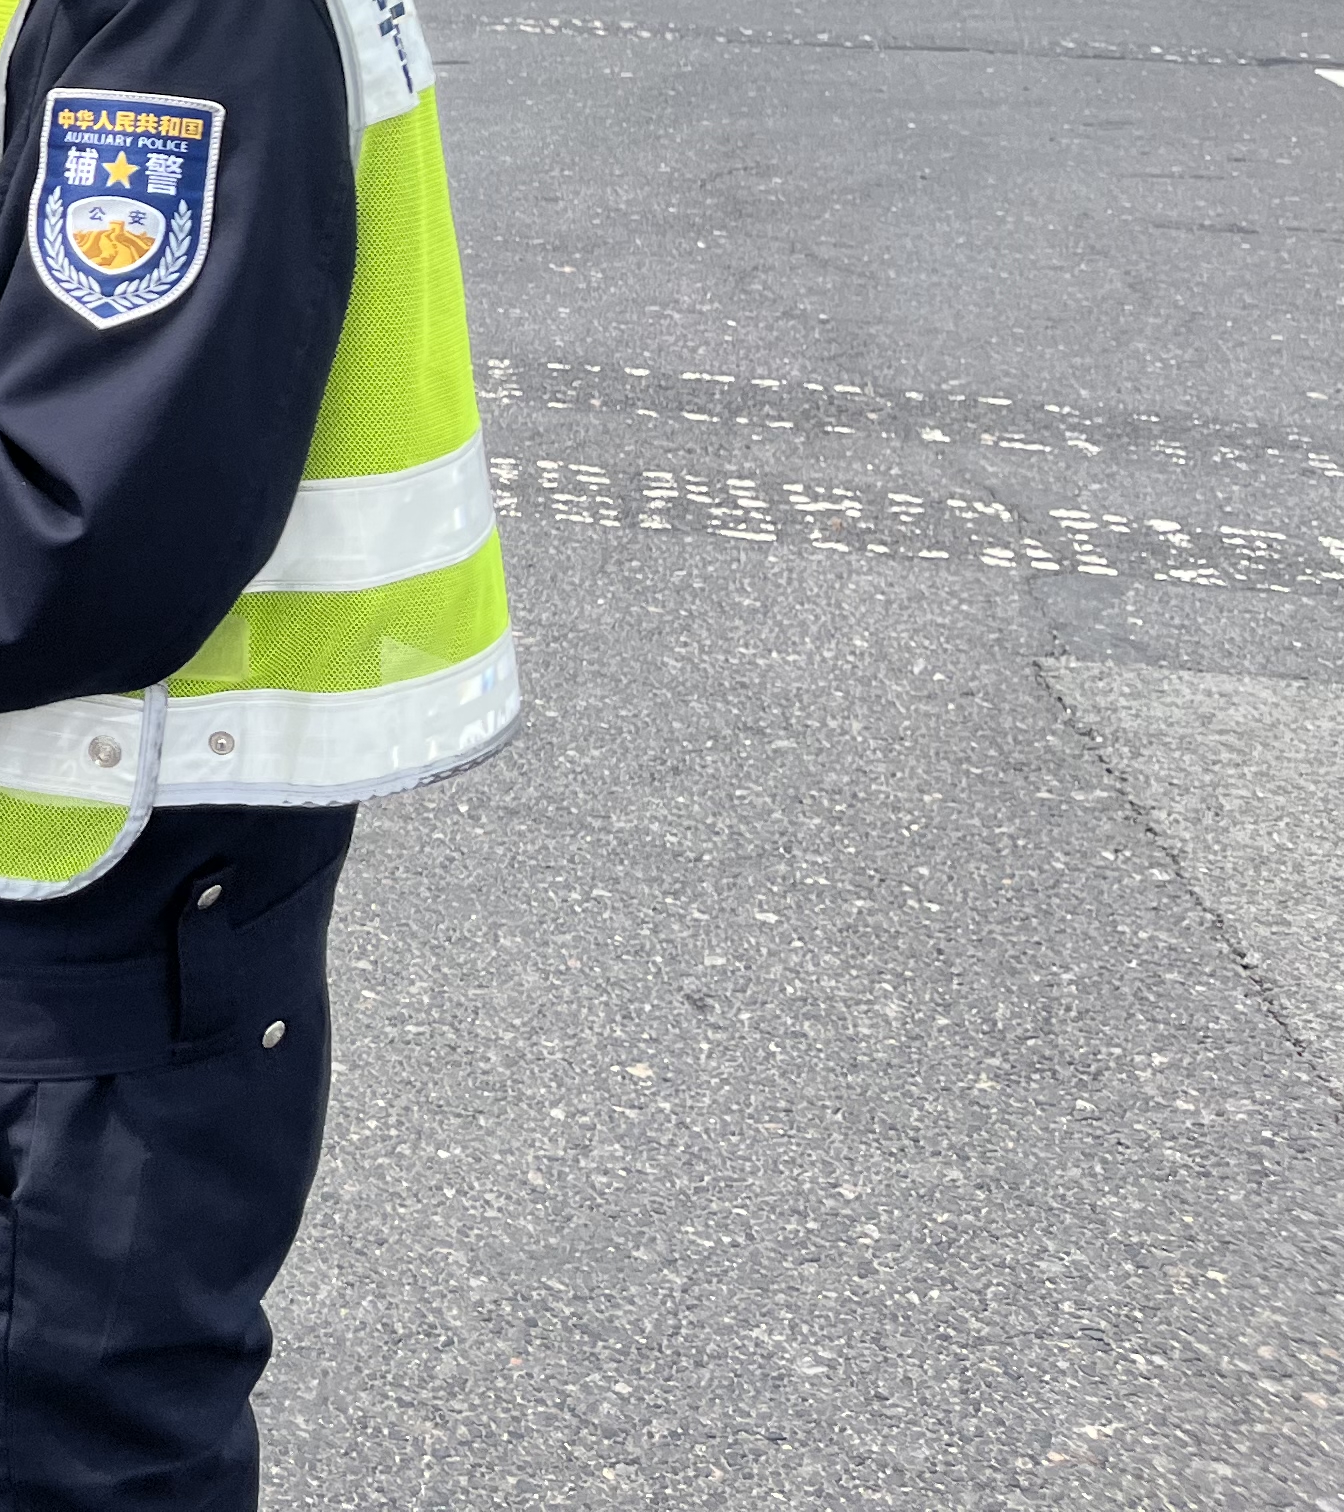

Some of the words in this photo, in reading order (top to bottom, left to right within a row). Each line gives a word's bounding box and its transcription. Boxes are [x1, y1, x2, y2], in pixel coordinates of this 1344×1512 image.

[58, 108, 204, 140] 中华人民共和国
[64, 131, 134, 147] AUXILIARY
[137, 136, 189, 153] POLICE
